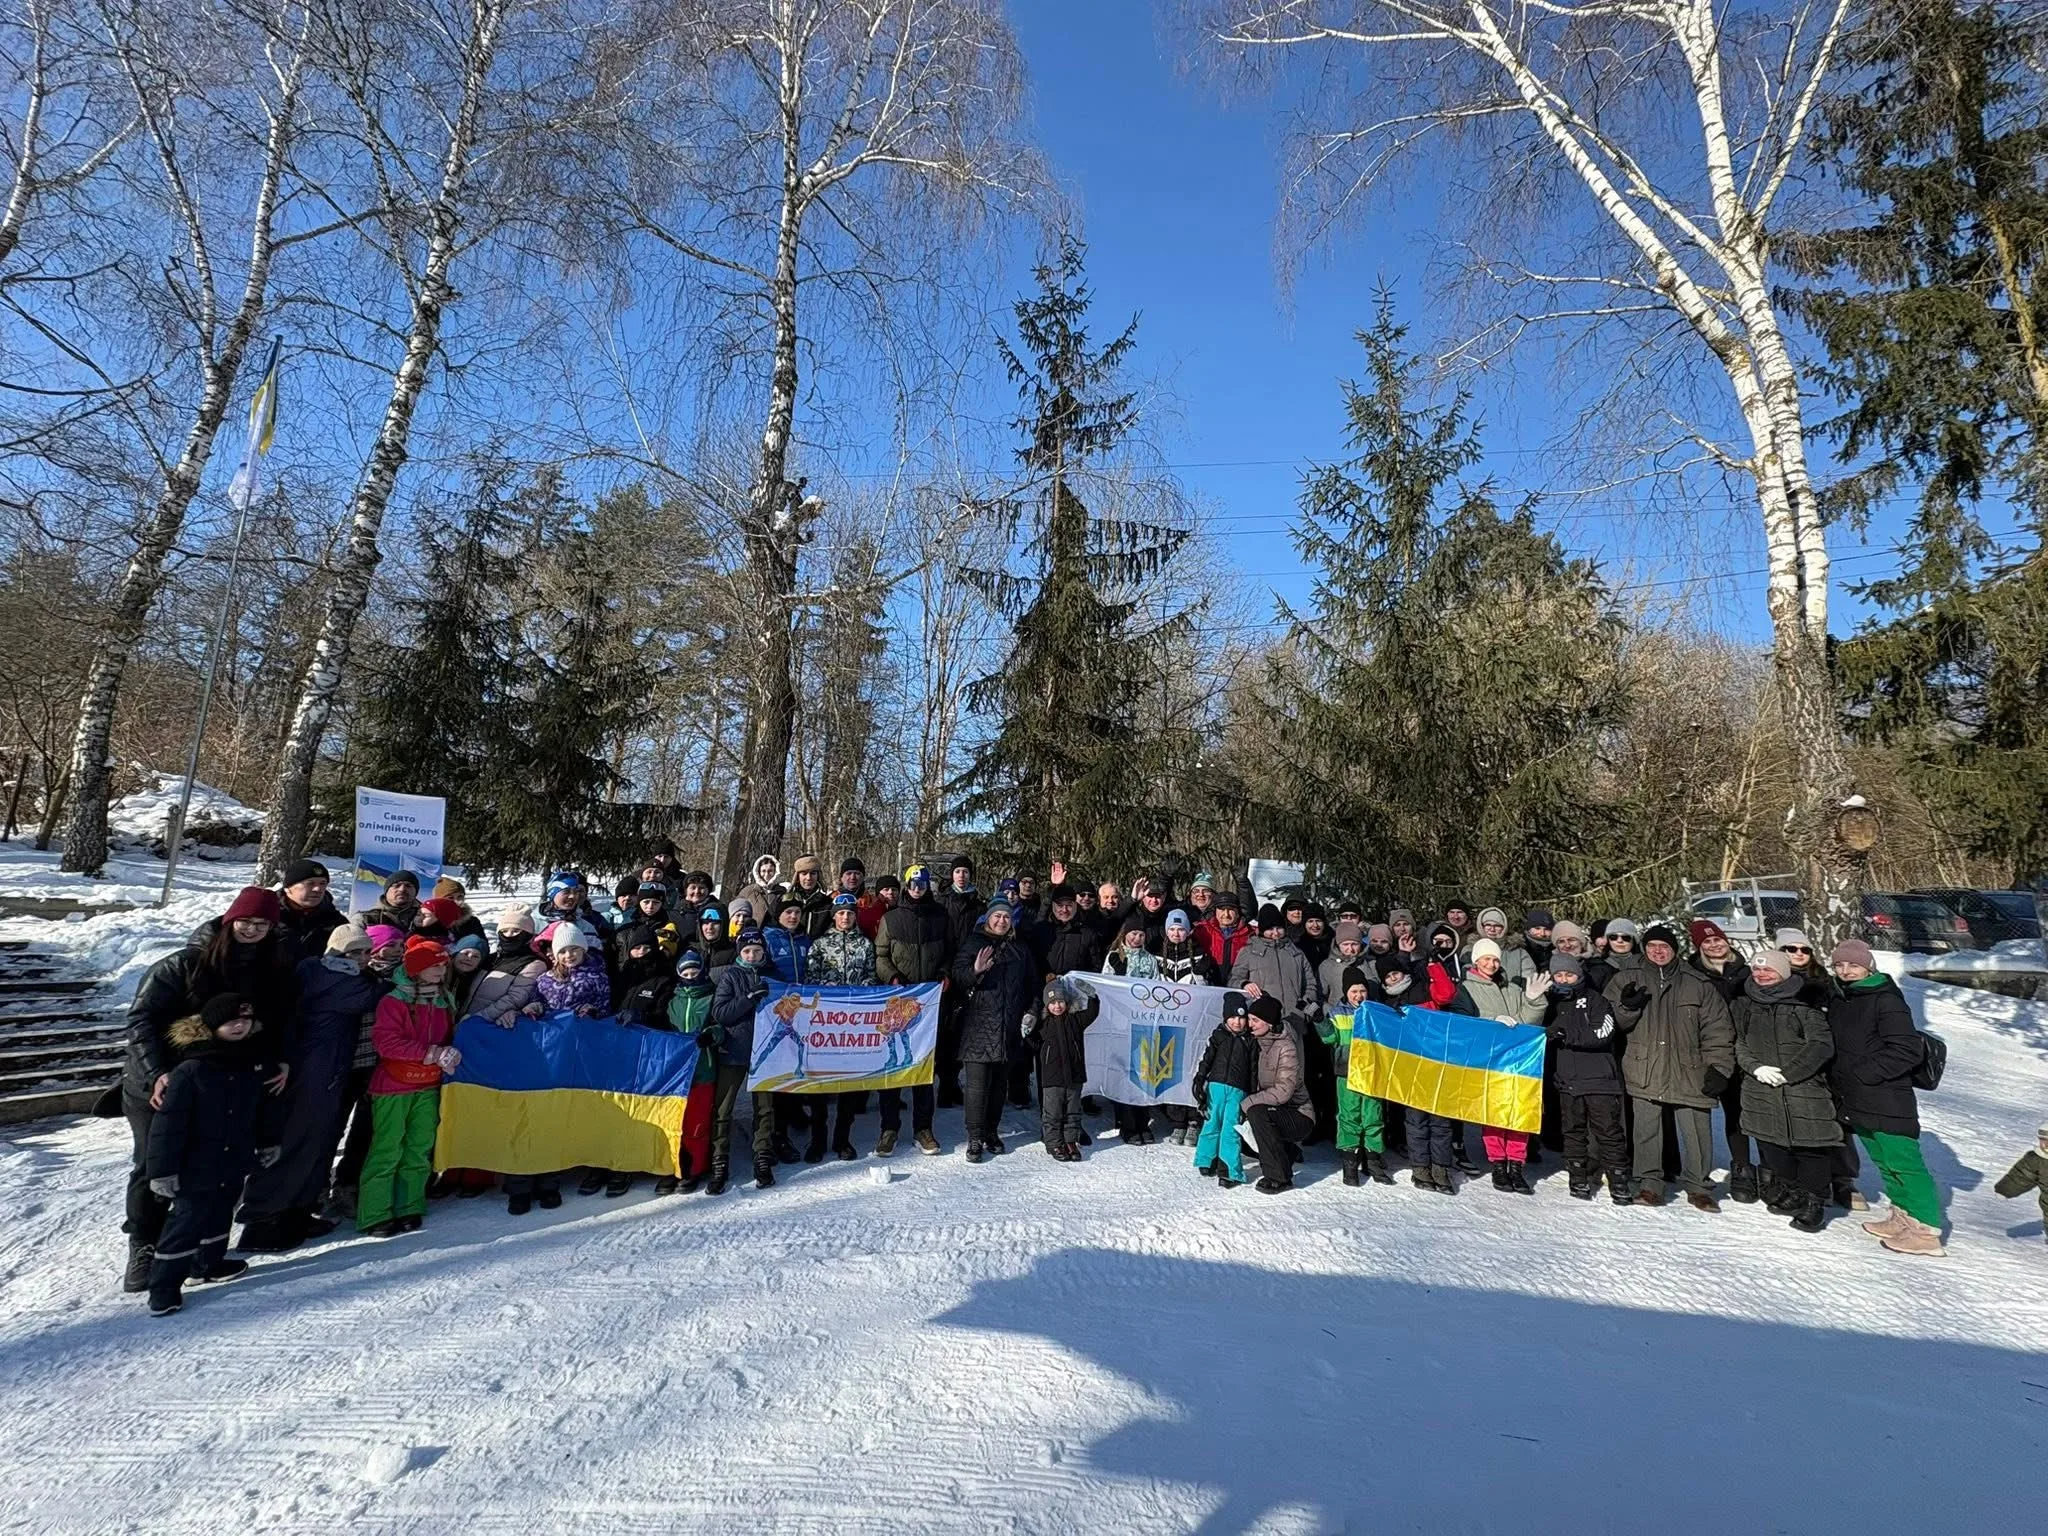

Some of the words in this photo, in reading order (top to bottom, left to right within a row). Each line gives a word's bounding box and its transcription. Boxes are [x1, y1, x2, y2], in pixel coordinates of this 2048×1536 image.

[383, 812, 416, 823] Свято
[358, 822, 438, 836] олімпійського
[374, 836, 421, 847] прапору
[809, 1010, 884, 1025] ДЮСШ
[1131, 1010, 1189, 1023] UKRAINE
